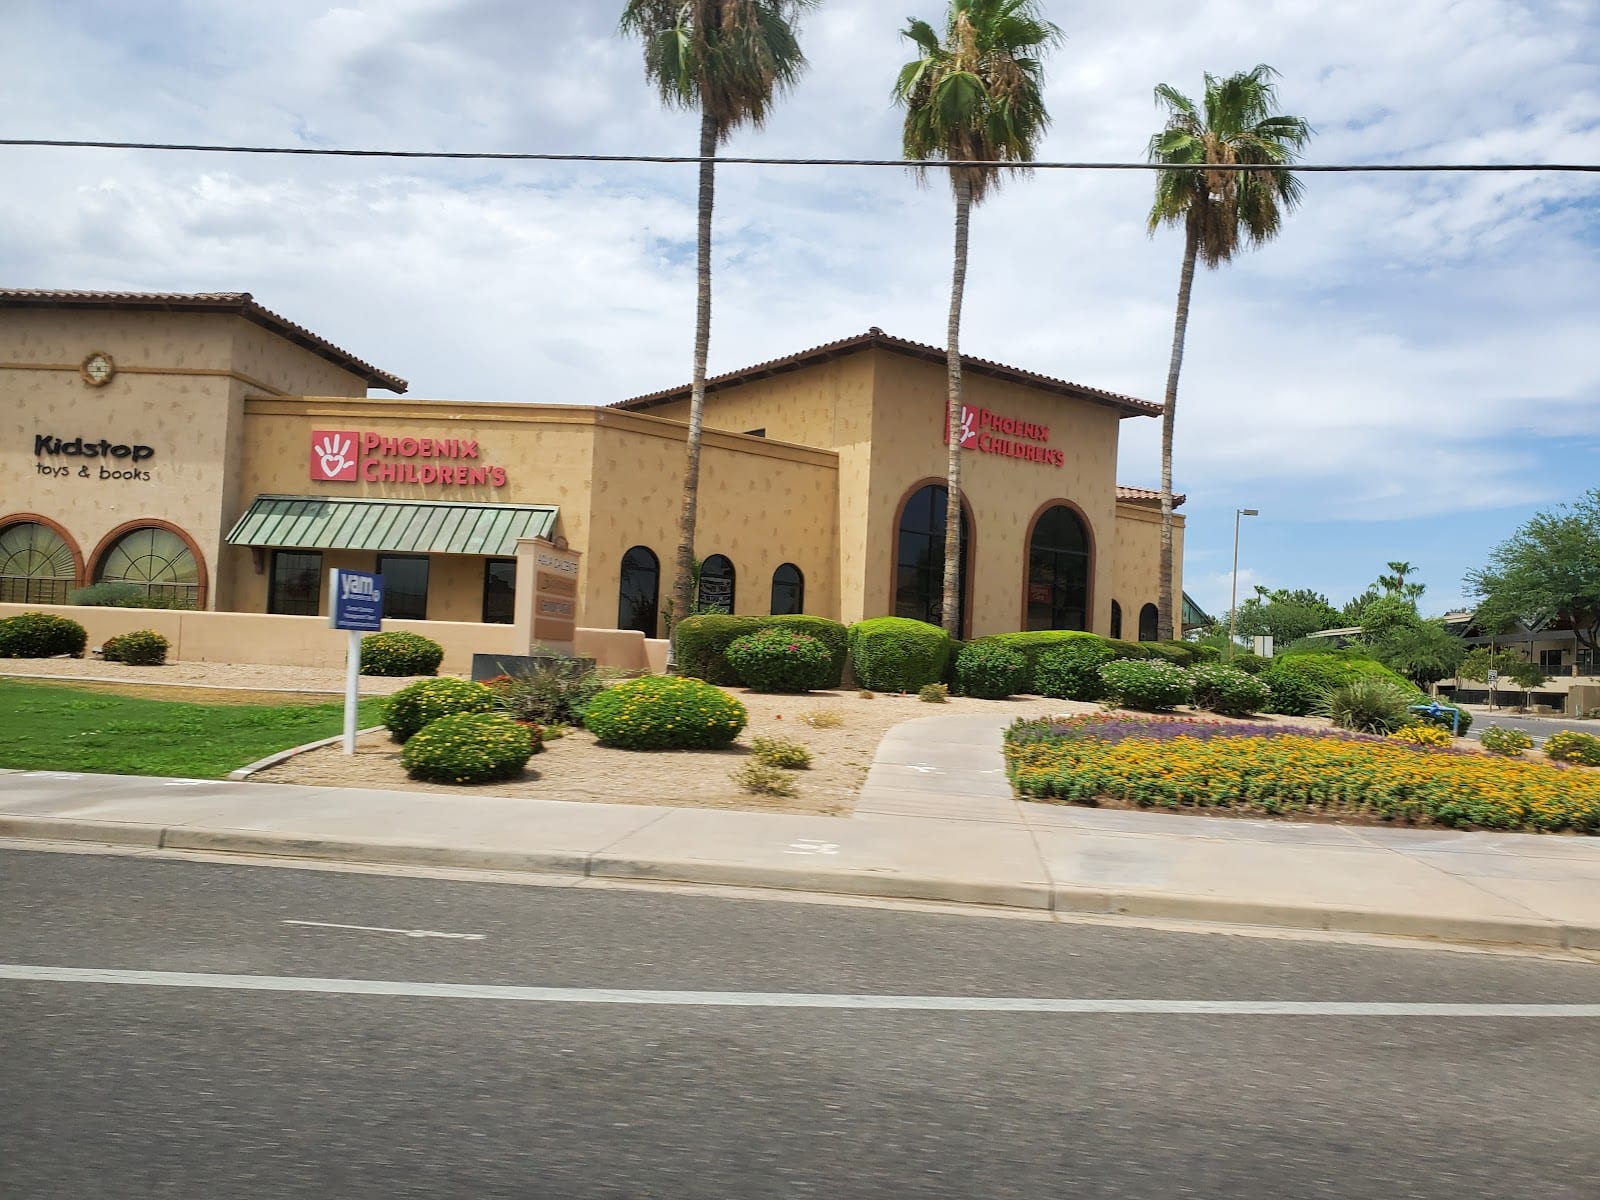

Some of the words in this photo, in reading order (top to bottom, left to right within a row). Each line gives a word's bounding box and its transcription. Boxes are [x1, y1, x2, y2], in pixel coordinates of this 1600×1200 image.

[980, 409, 1050, 442] PHOENIX
[35, 434, 154, 462] Kidstop
[363, 432, 478, 458] PHOENIX
[979, 431, 1065, 467] CHILDREN'S
[36, 462, 70, 478] toys
[78, 465, 90, 478] &
[99, 466, 151, 481] books
[361, 458, 506, 487] CHILDREN'S
